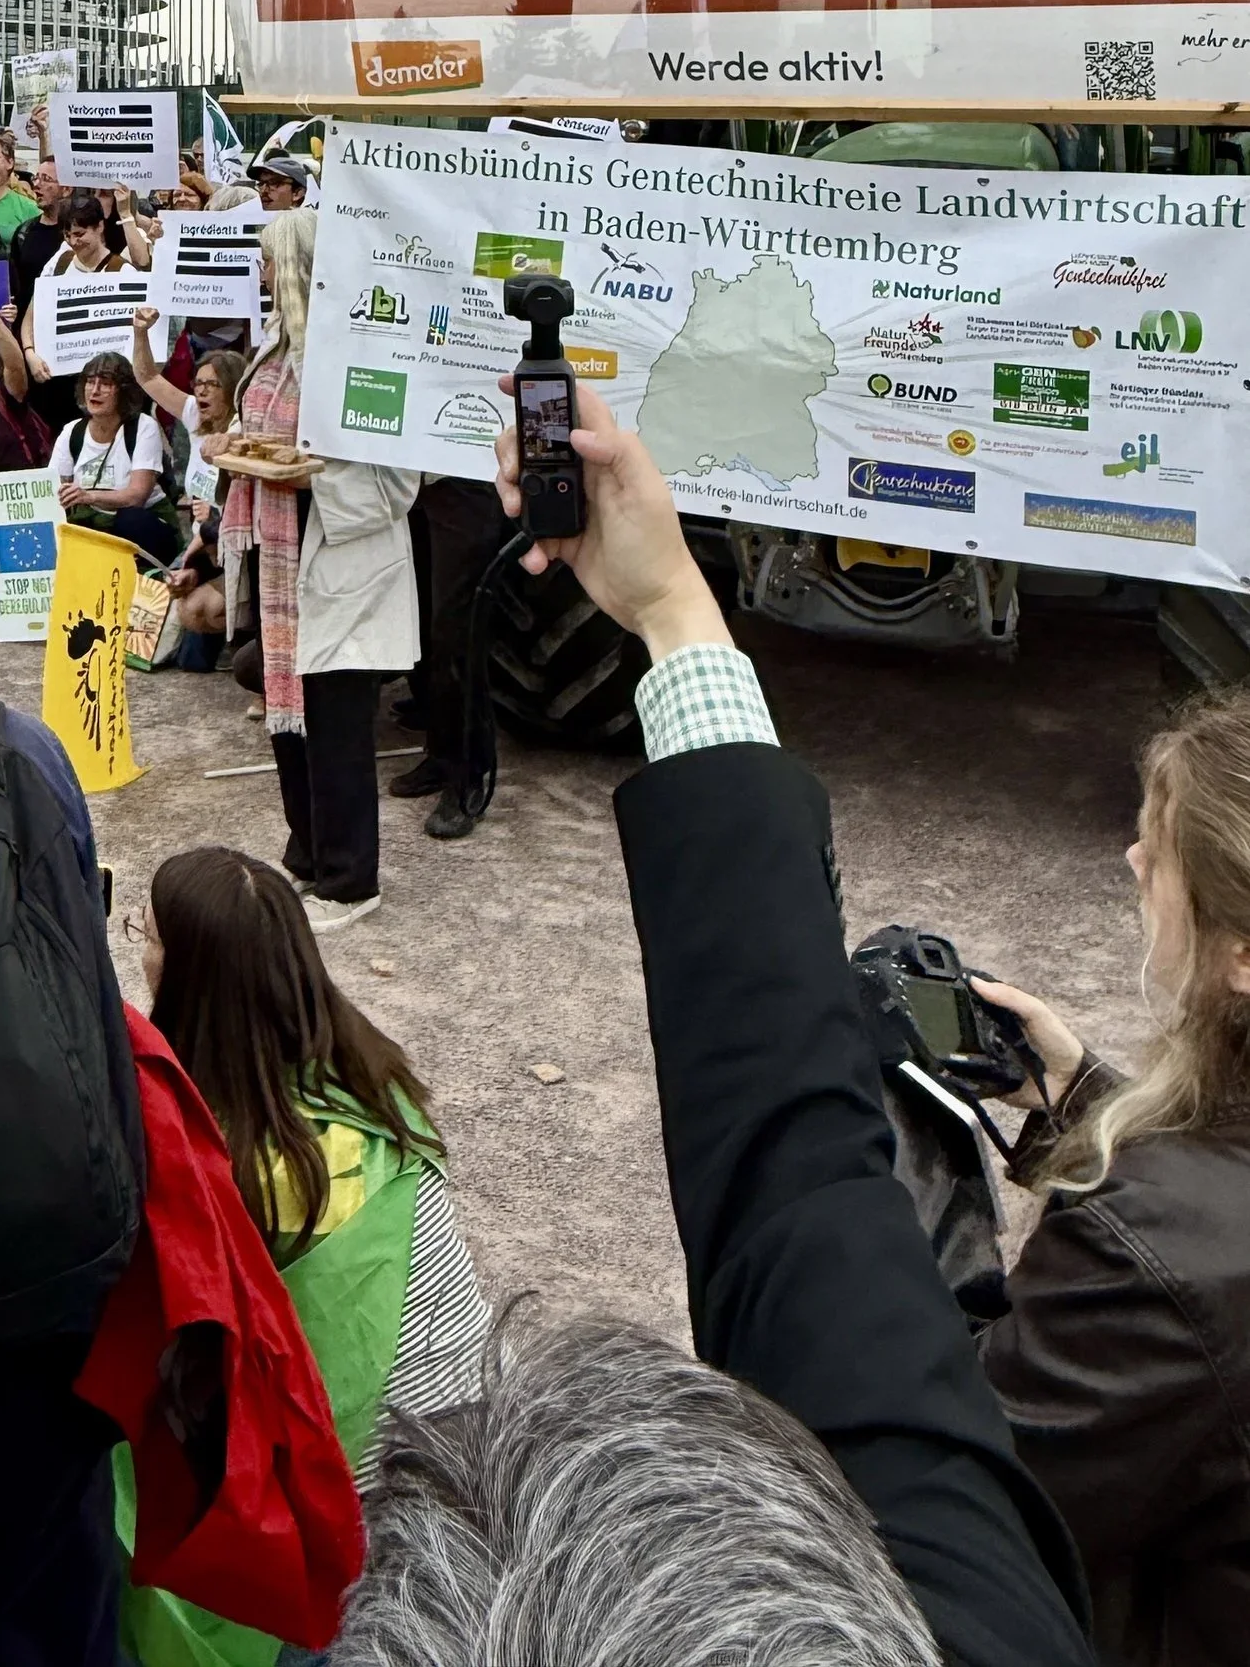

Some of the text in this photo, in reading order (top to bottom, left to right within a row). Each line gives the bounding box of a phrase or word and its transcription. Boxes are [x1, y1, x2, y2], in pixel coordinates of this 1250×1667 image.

[1181, 28, 1228, 47] mehr
[365, 56, 468, 86] demeter
[648, 50, 882, 82] Werde aktiv!
[340, 139, 1247, 230] Aktionsbündnis Gentechnikfreie Landwirtschaft
[537, 202, 961, 275] in Baden-Württemberg
[603, 281, 673, 302] NABU
[894, 282, 1001, 305] Naturland
[870, 326, 907, 341] Natur
[1115, 330, 1171, 352] LNV
[419, 352, 439, 364] Pro
[894, 383, 957, 403] BUND
[346, 409, 399, 432] Bioland
[31, 480, 54, 498] OUR
[7, 502, 34, 520] FOOD
[4, 578, 29, 595] STOP
